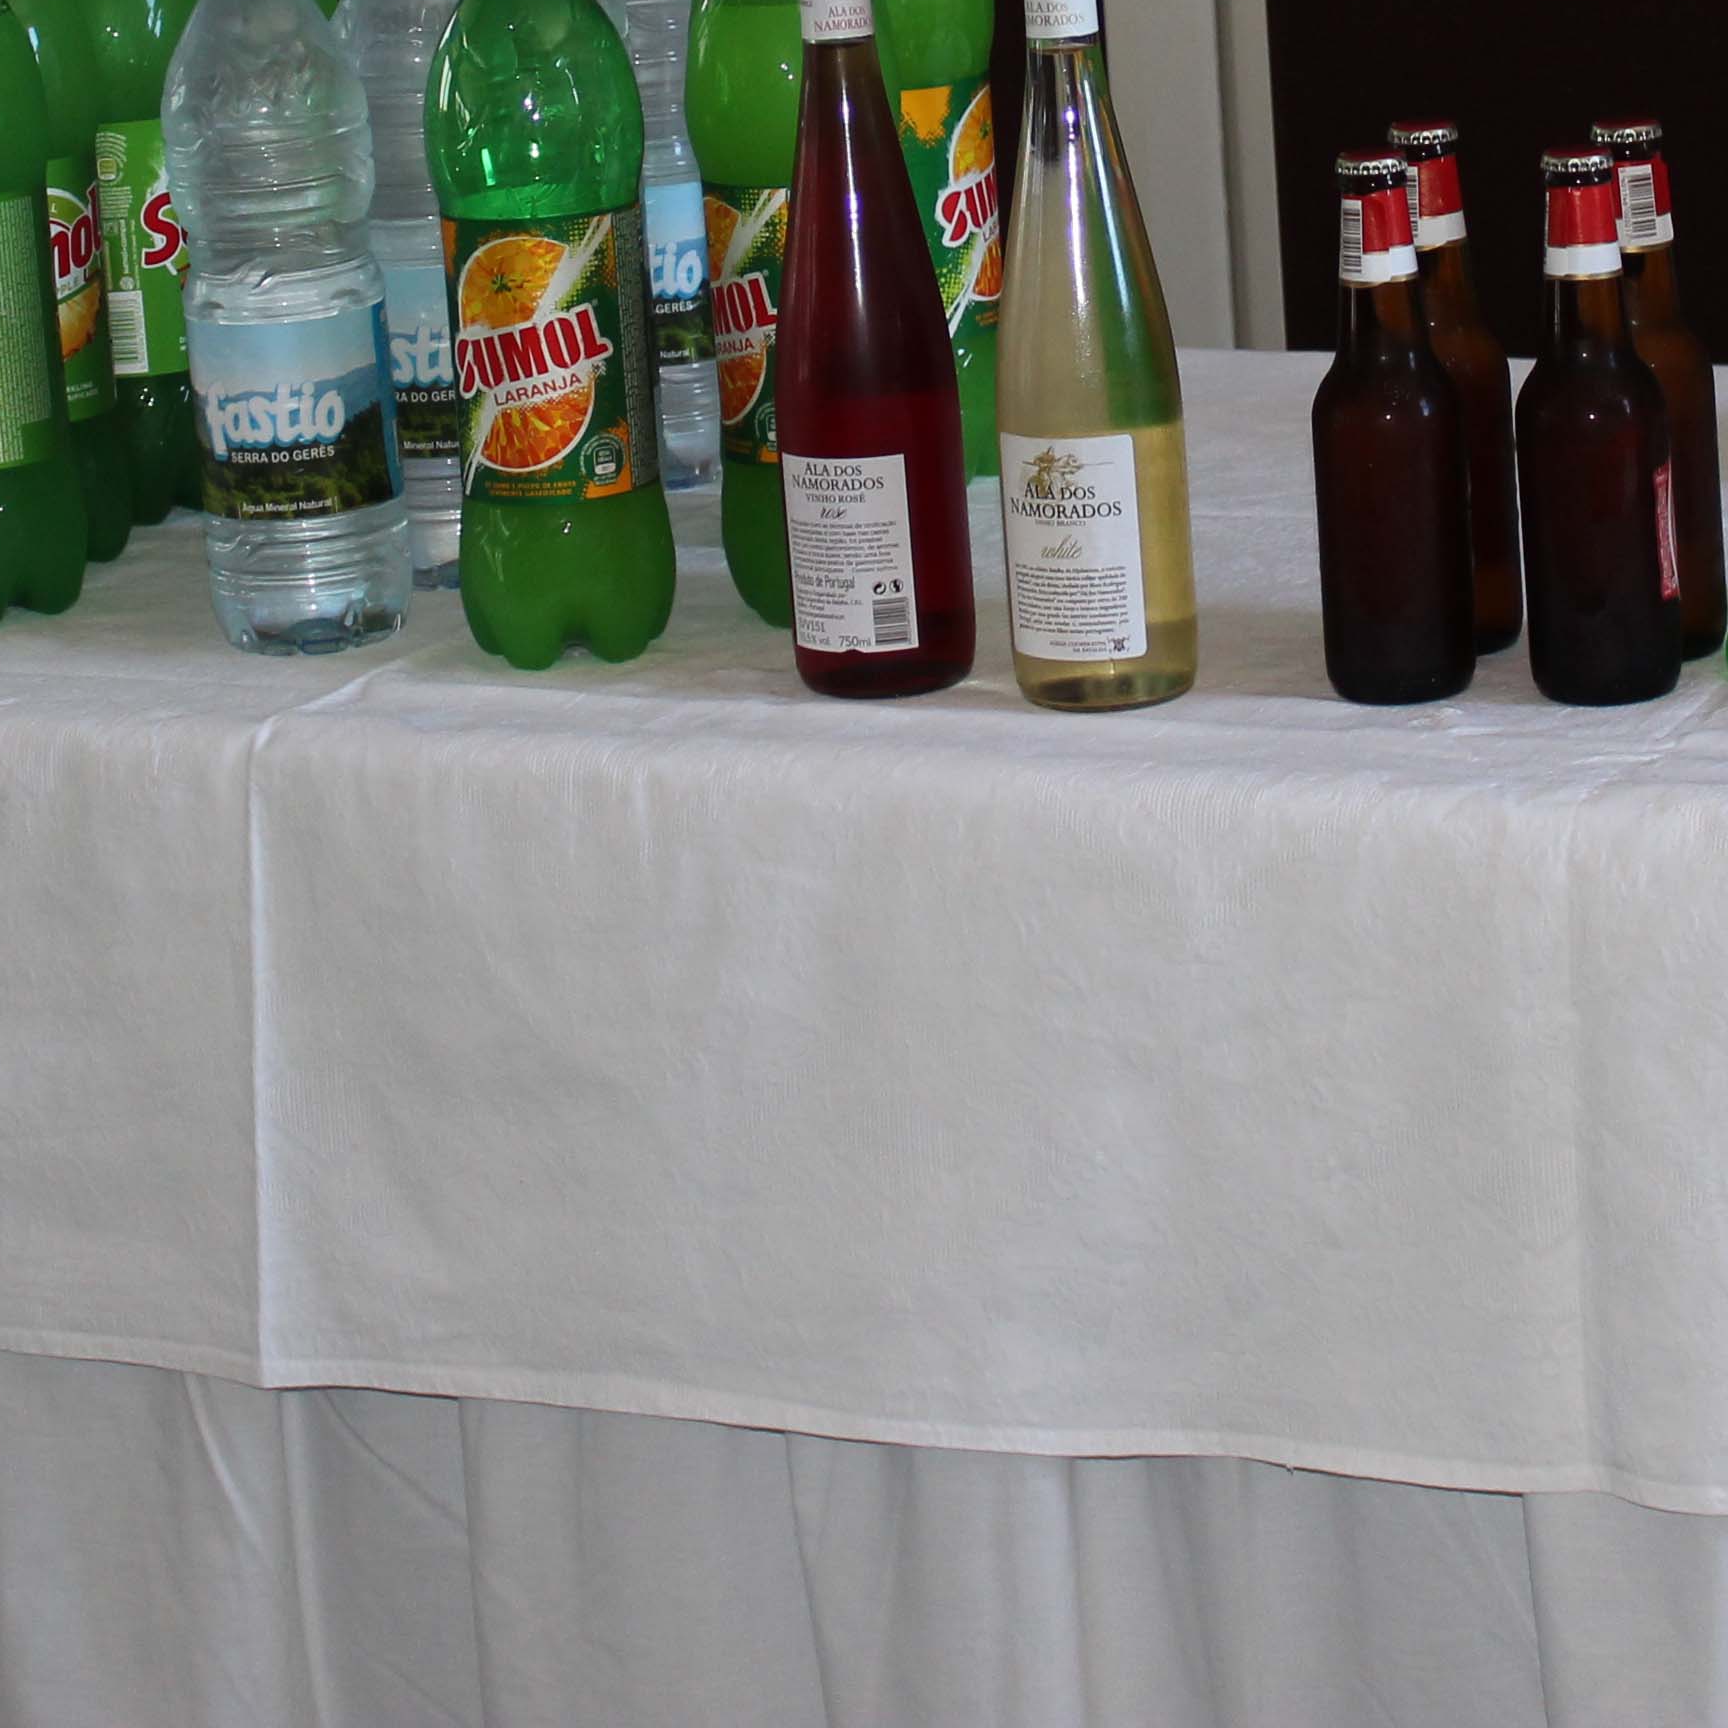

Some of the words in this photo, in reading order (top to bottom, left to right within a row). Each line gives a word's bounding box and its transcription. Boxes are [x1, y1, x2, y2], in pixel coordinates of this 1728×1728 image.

[456, 308, 609, 394] SUMOL
[431, 390, 457, 402] GER
[493, 372, 583, 407] LARANJA
[205, 382, 346, 457] fastio
[231, 450, 269, 465] SERRA
[271, 450, 289, 464] DO
[291, 445, 336, 462] GERÊS
[804, 461, 830, 477] ALA
[833, 465, 863, 478] DOS
[792, 474, 885, 492] NAMORADOS
[1024, 481, 1056, 501] ALA
[1060, 485, 1097, 501] DOS
[1010, 497, 1123, 520] NAMORADOS
[1040, 534, 1083, 560] white
[824, 574, 855, 592] Portugal
[839, 635, 872, 647] 750ml
